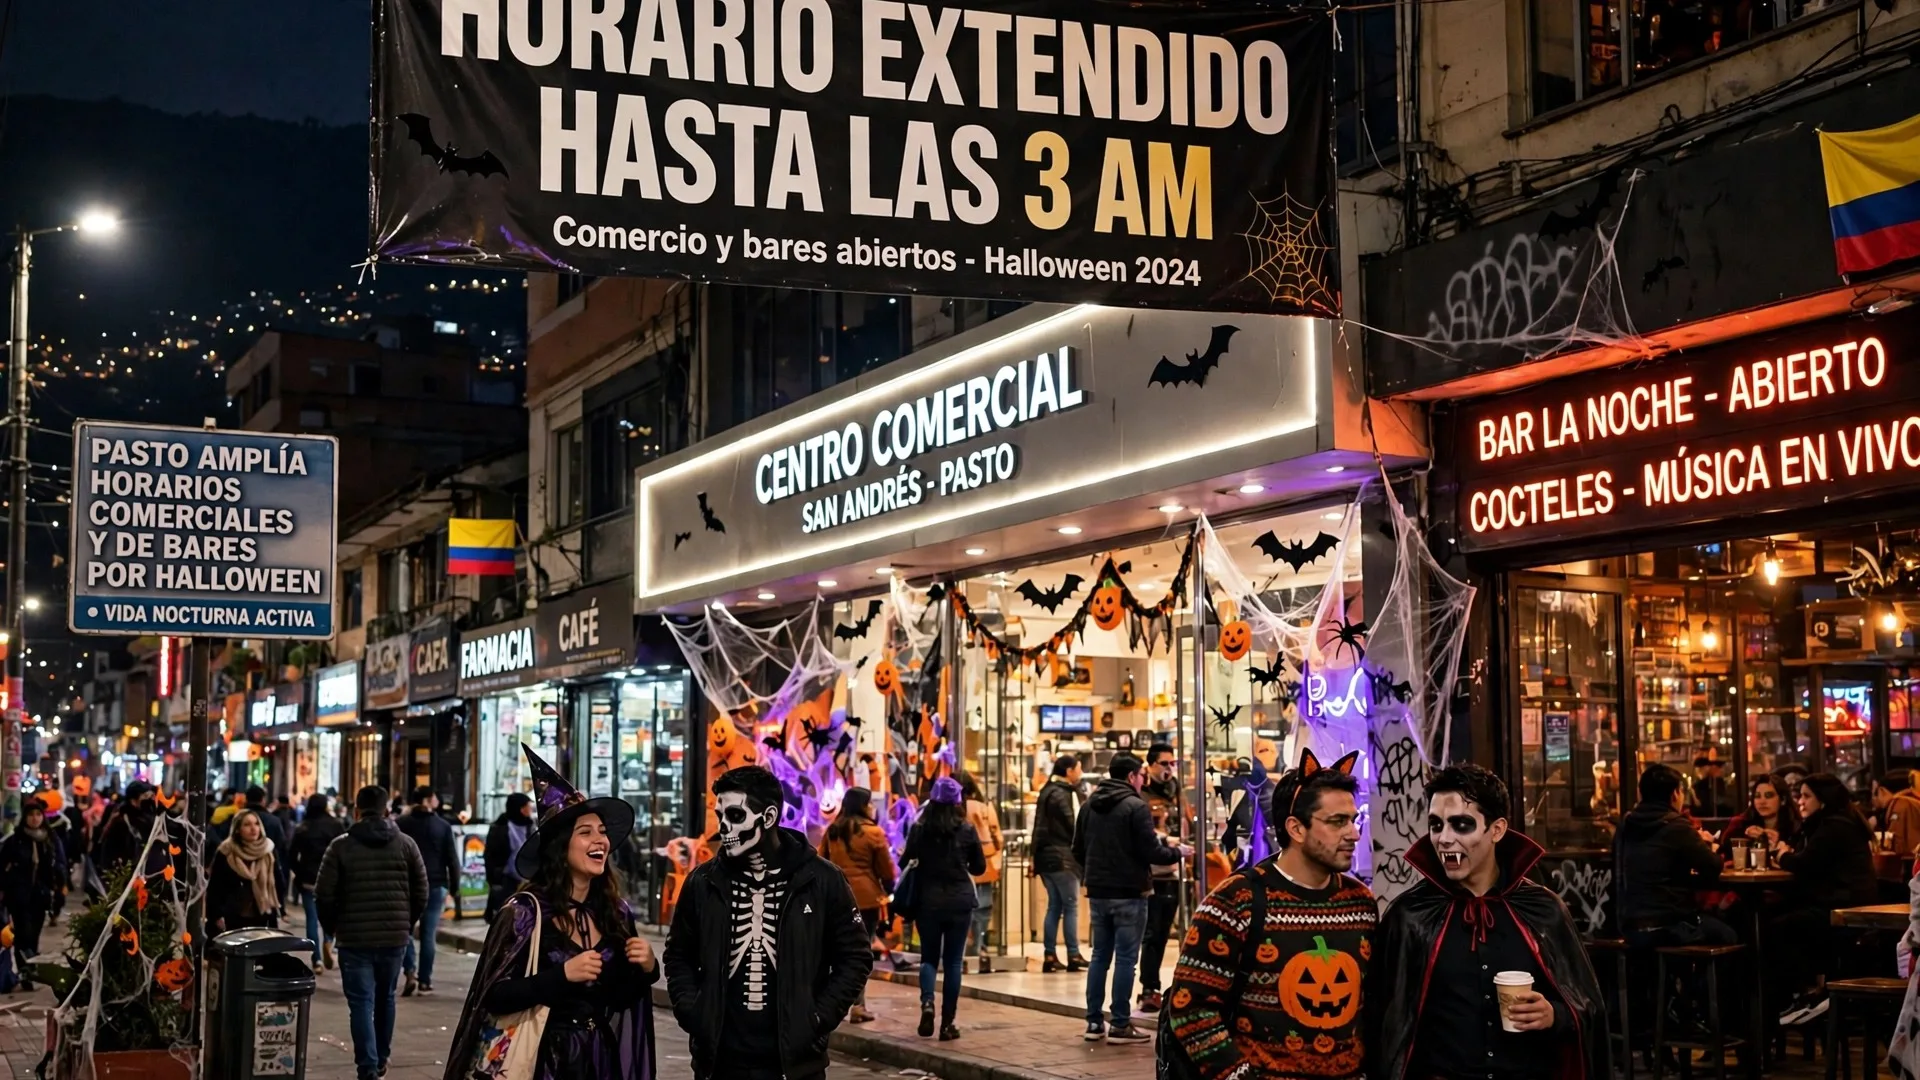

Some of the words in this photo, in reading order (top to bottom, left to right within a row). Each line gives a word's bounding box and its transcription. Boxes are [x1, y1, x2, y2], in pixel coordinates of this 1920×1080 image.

[440, 0, 834, 93] HORARIO
[862, 0, 1288, 135] EXTENDIDO
[540, 86, 824, 213] HASTA
[849, 115, 1000, 225] LAS
[1024, 130, 1072, 230] 3
[1094, 137, 1213, 240] AM
[553, 215, 707, 255] Comercio
[716, 233, 733, 263] y
[743, 229, 828, 264] bares
[836, 236, 956, 272] abiertos
[985, 246, 1127, 283] Halloween
[1135, 256, 1201, 287] 2024
[755, 422, 864, 505] CENTRO
[871, 345, 1083, 467] COMERCIAL
[1479, 411, 1534, 461] BAR
[1542, 402, 1579, 447] LA
[1588, 376, 1694, 440] NOCHE
[1728, 337, 1886, 413] ABIERTO
[91, 438, 189, 468] PASTO
[198, 443, 307, 475] AMPLÍA
[1470, 470, 1614, 533] COCTELES
[1644, 446, 1771, 506] MÚSICA
[1780, 433, 1827, 486] EN
[1837, 416, 1920, 476] VIVO
[91, 470, 241, 502] HORARIOS
[802, 494, 838, 534] SAN
[842, 465, 921, 524] ANDRÉS
[940, 442, 1015, 496] PASTO
[89, 500, 293, 535] COMERCIALES
[88, 530, 108, 556] Y
[116, 531, 154, 558] DE
[163, 534, 257, 562] BARES
[88, 562, 147, 588] POR
[156, 564, 321, 594] HALLOWEEN
[104, 604, 148, 623] VIDA
[152, 605, 250, 625] NOCTURNA
[254, 608, 316, 628] ACTIVA
[559, 598, 599, 652] CAFÉ
[460, 627, 534, 680] FARMACIA
